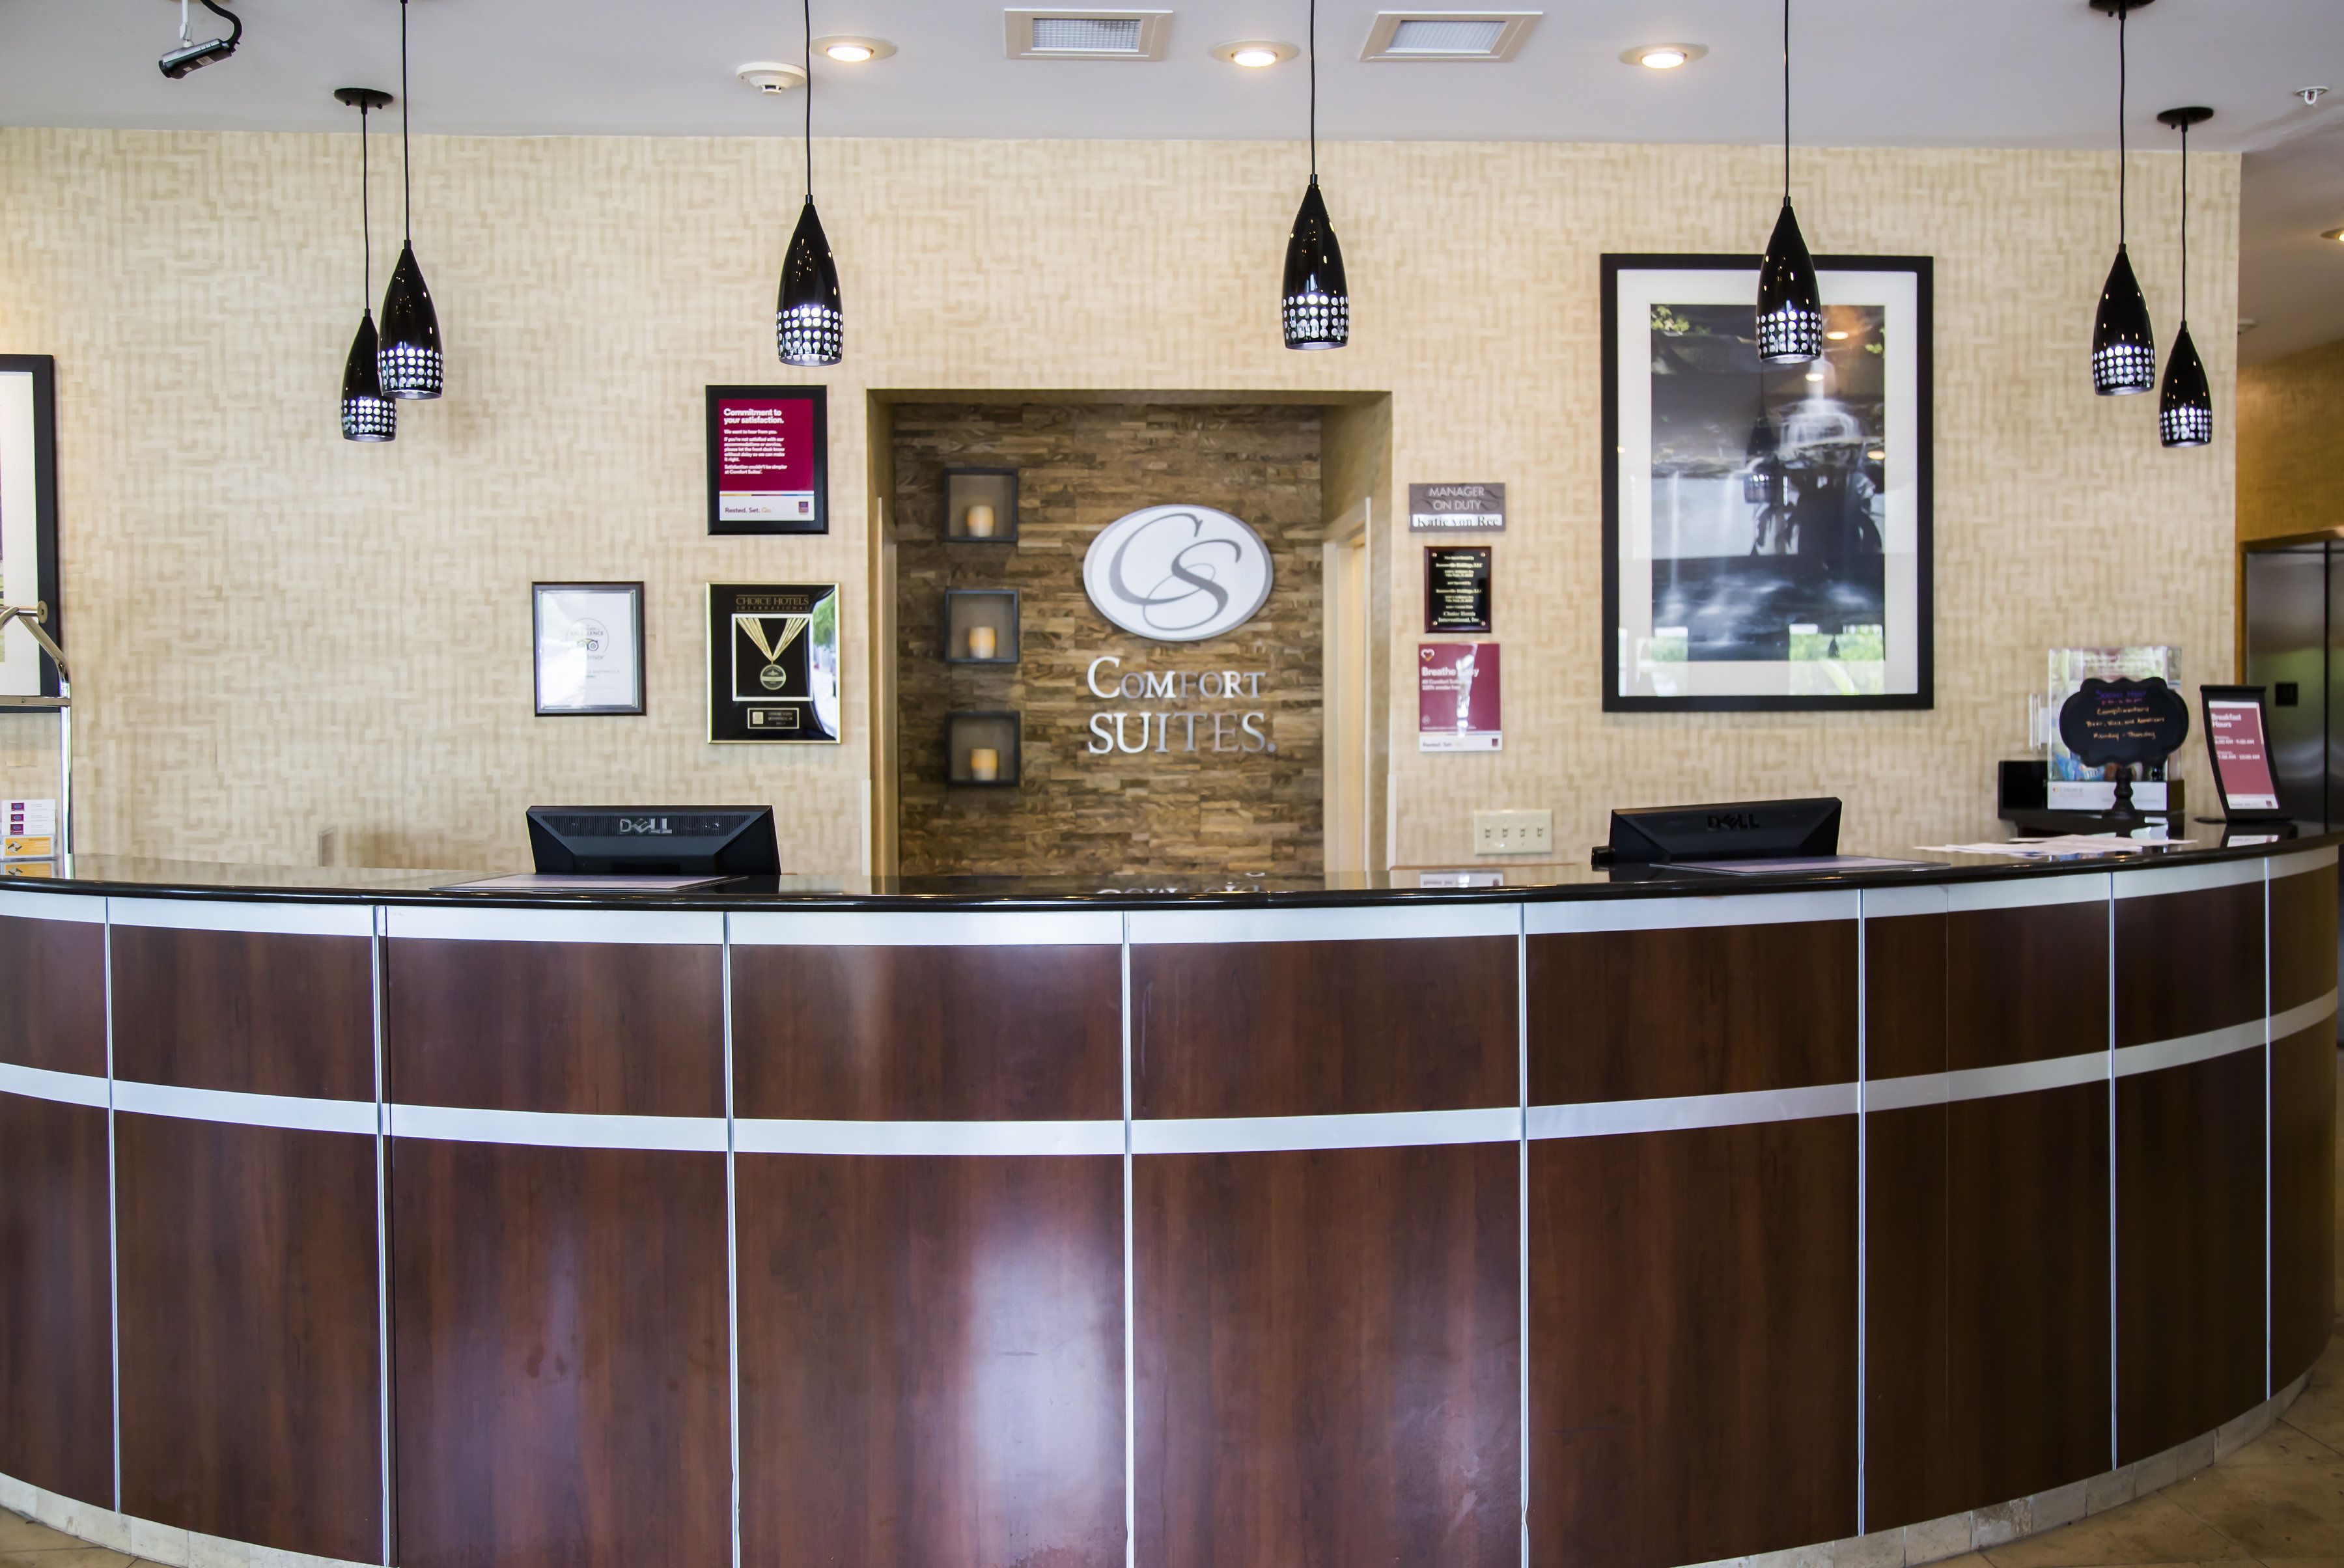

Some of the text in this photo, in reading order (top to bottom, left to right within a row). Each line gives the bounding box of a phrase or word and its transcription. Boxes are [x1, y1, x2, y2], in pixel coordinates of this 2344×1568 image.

[1427, 486, 1485, 497] MANAGER
[1433, 499, 1482, 511] ON DUTY
[1417, 516, 1448, 527] Katie
[1421, 666, 1457, 676] Breathe
[1087, 656, 1266, 699] COMFORT
[2211, 713, 2242, 721] Breakfast
[619, 818, 673, 834] DELL
[1707, 813, 1761, 832] DELL
